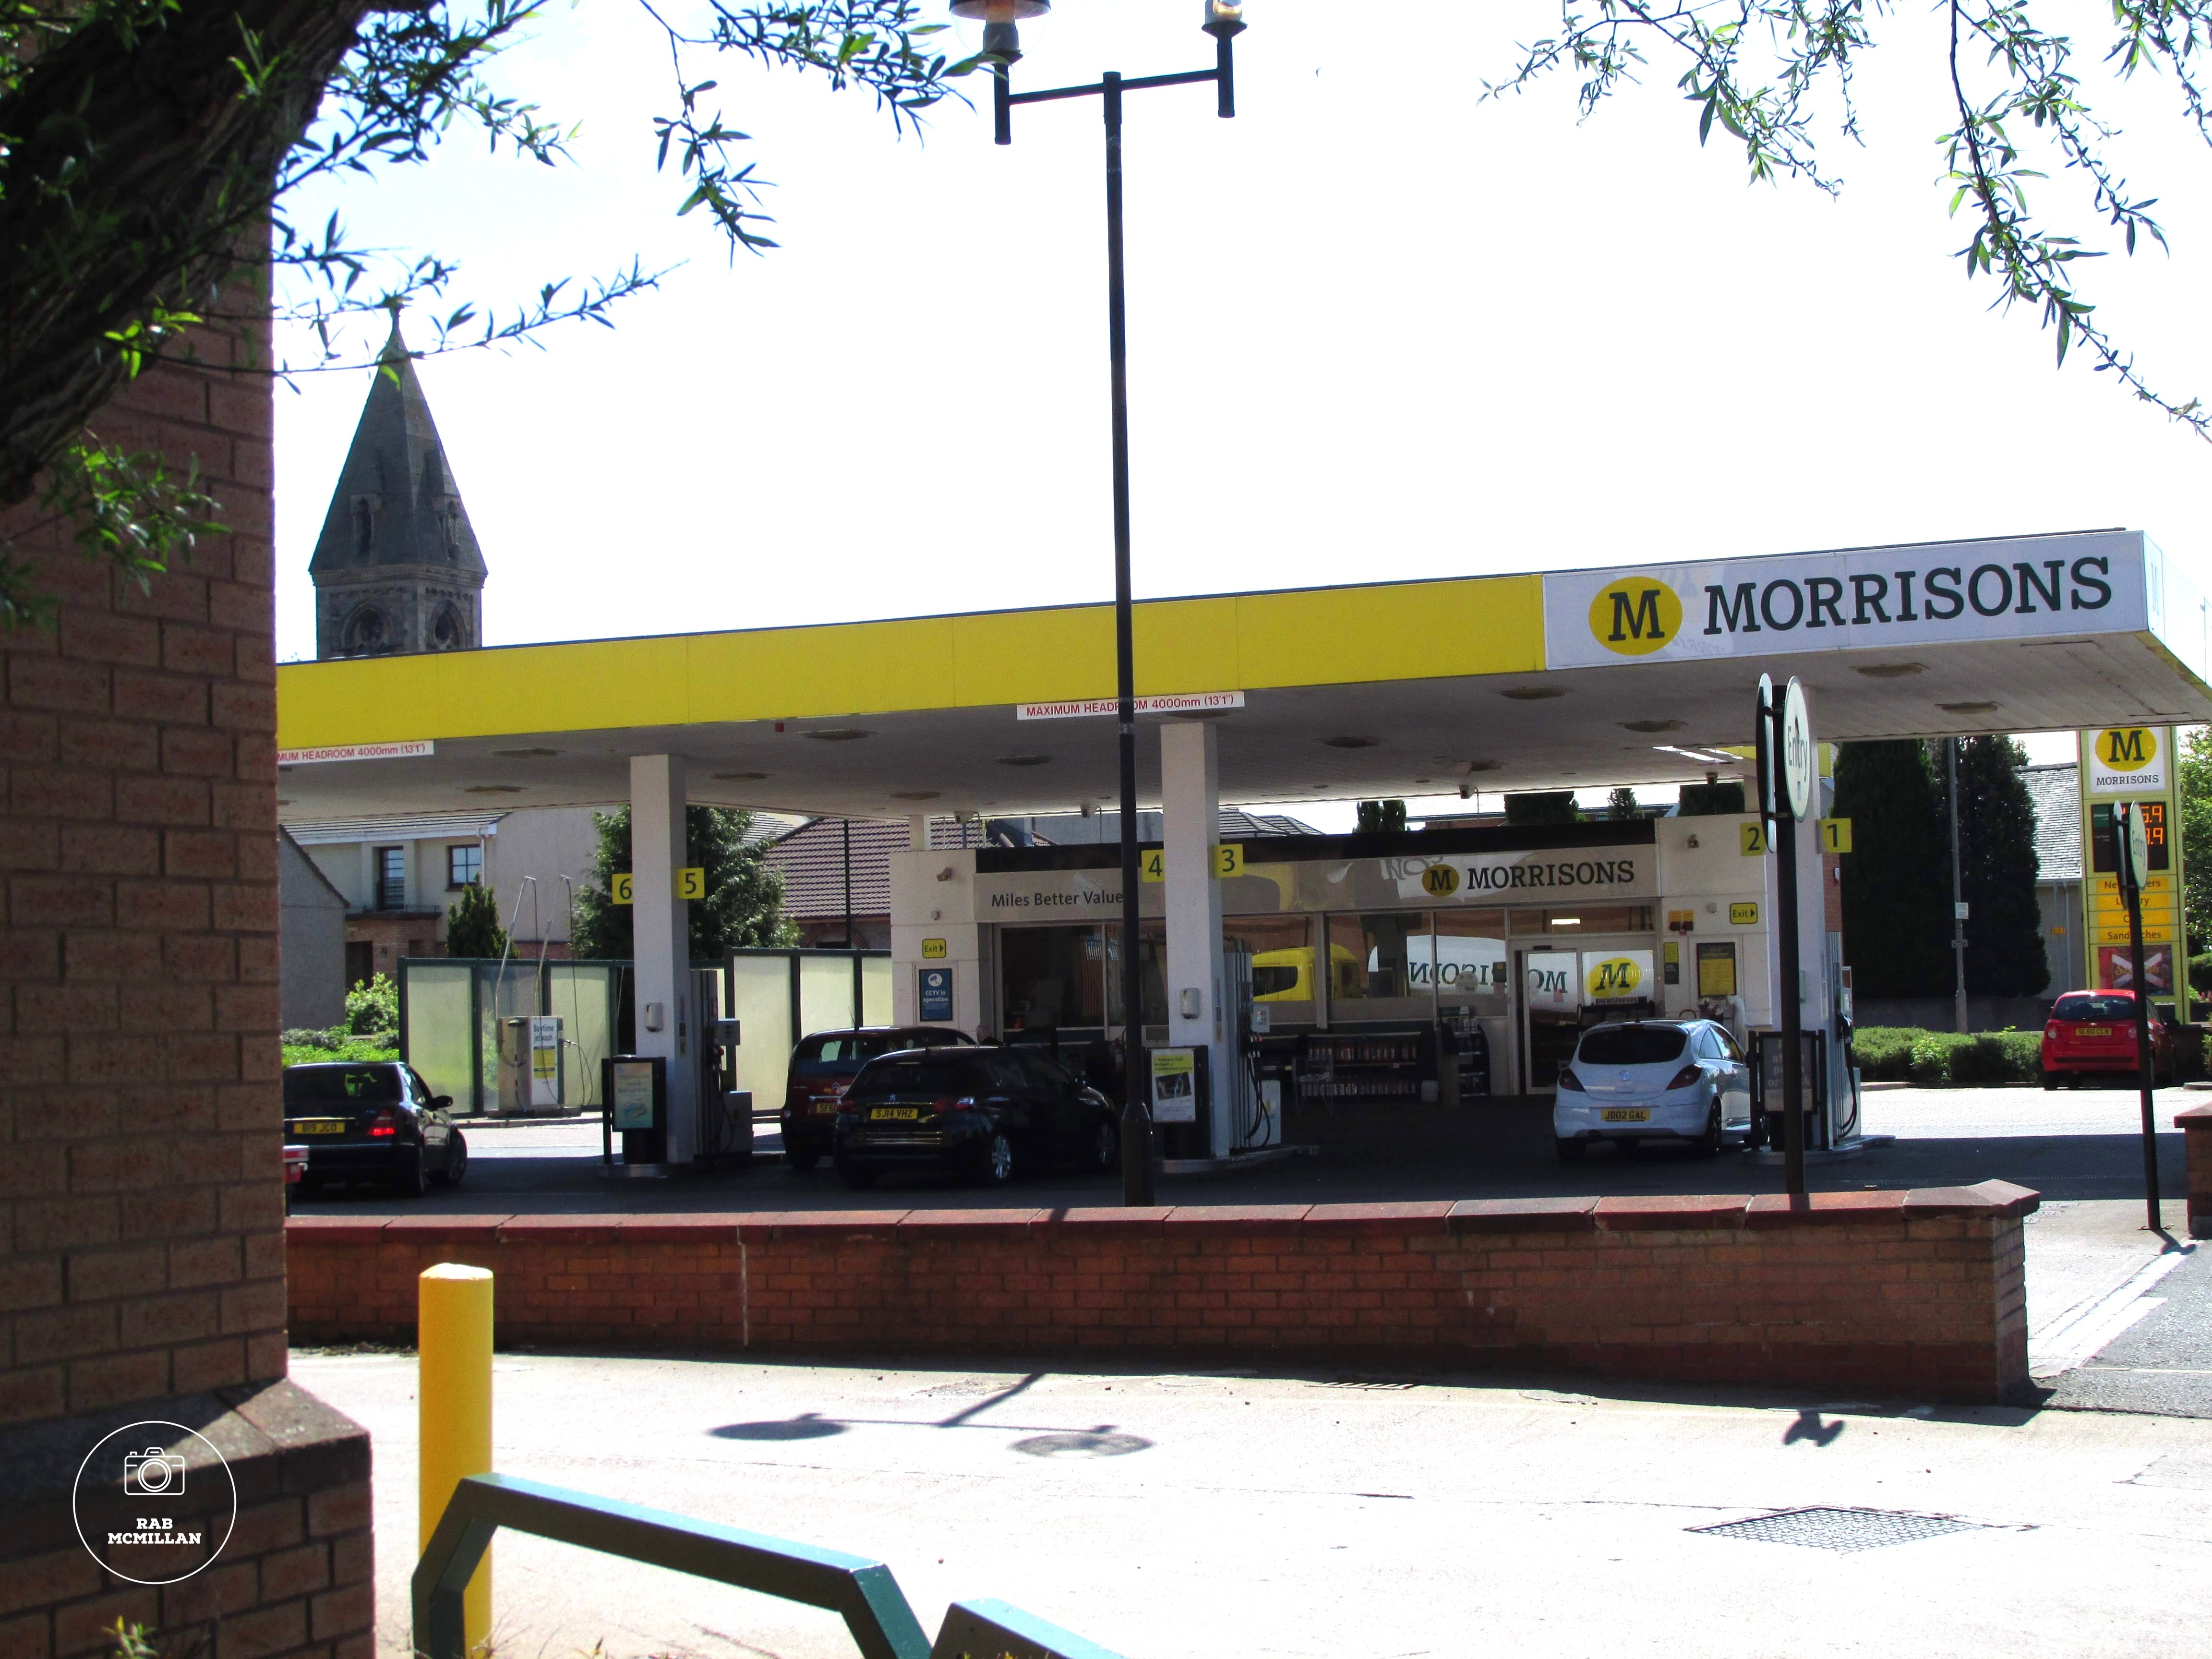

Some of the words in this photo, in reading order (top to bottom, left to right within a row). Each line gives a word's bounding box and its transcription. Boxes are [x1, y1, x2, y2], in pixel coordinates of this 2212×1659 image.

[1608, 589, 1665, 641] M
[1703, 556, 2112, 635] MORRISONS
[1027, 704, 1080, 716] MAXIMUM
[1152, 697, 1200, 709] 4000mm
[302, 748, 355, 760] HEADROOM
[358, 746, 398, 757] 4000mm
[1788, 726, 1807, 782] Entry
[2108, 730, 2145, 762] M
[2096, 774, 2159, 786] MORRISONS
[1748, 827, 1760, 851] 2
[1827, 824, 1838, 847] 1
[1148, 854, 1162, 877] 4
[1221, 849, 1236, 872] 3
[685, 873, 697, 894] 5
[1430, 870, 1453, 891] M
[1467, 860, 1635, 890] MORRISONS
[2104, 880, 2160, 889] Neers
[619, 878, 632, 900] 6
[992, 893, 1029, 907] Miles
[1035, 892, 1079, 905] Better
[1083, 890, 1123, 904] Value
[1732, 910, 1748, 918] Exit
[2108, 930, 2162, 939] Sandches
[876, 1109, 894, 1118] SJ14
[897, 1109, 913, 1118] VHZ
[1629, 1111, 1646, 1119] GAL
